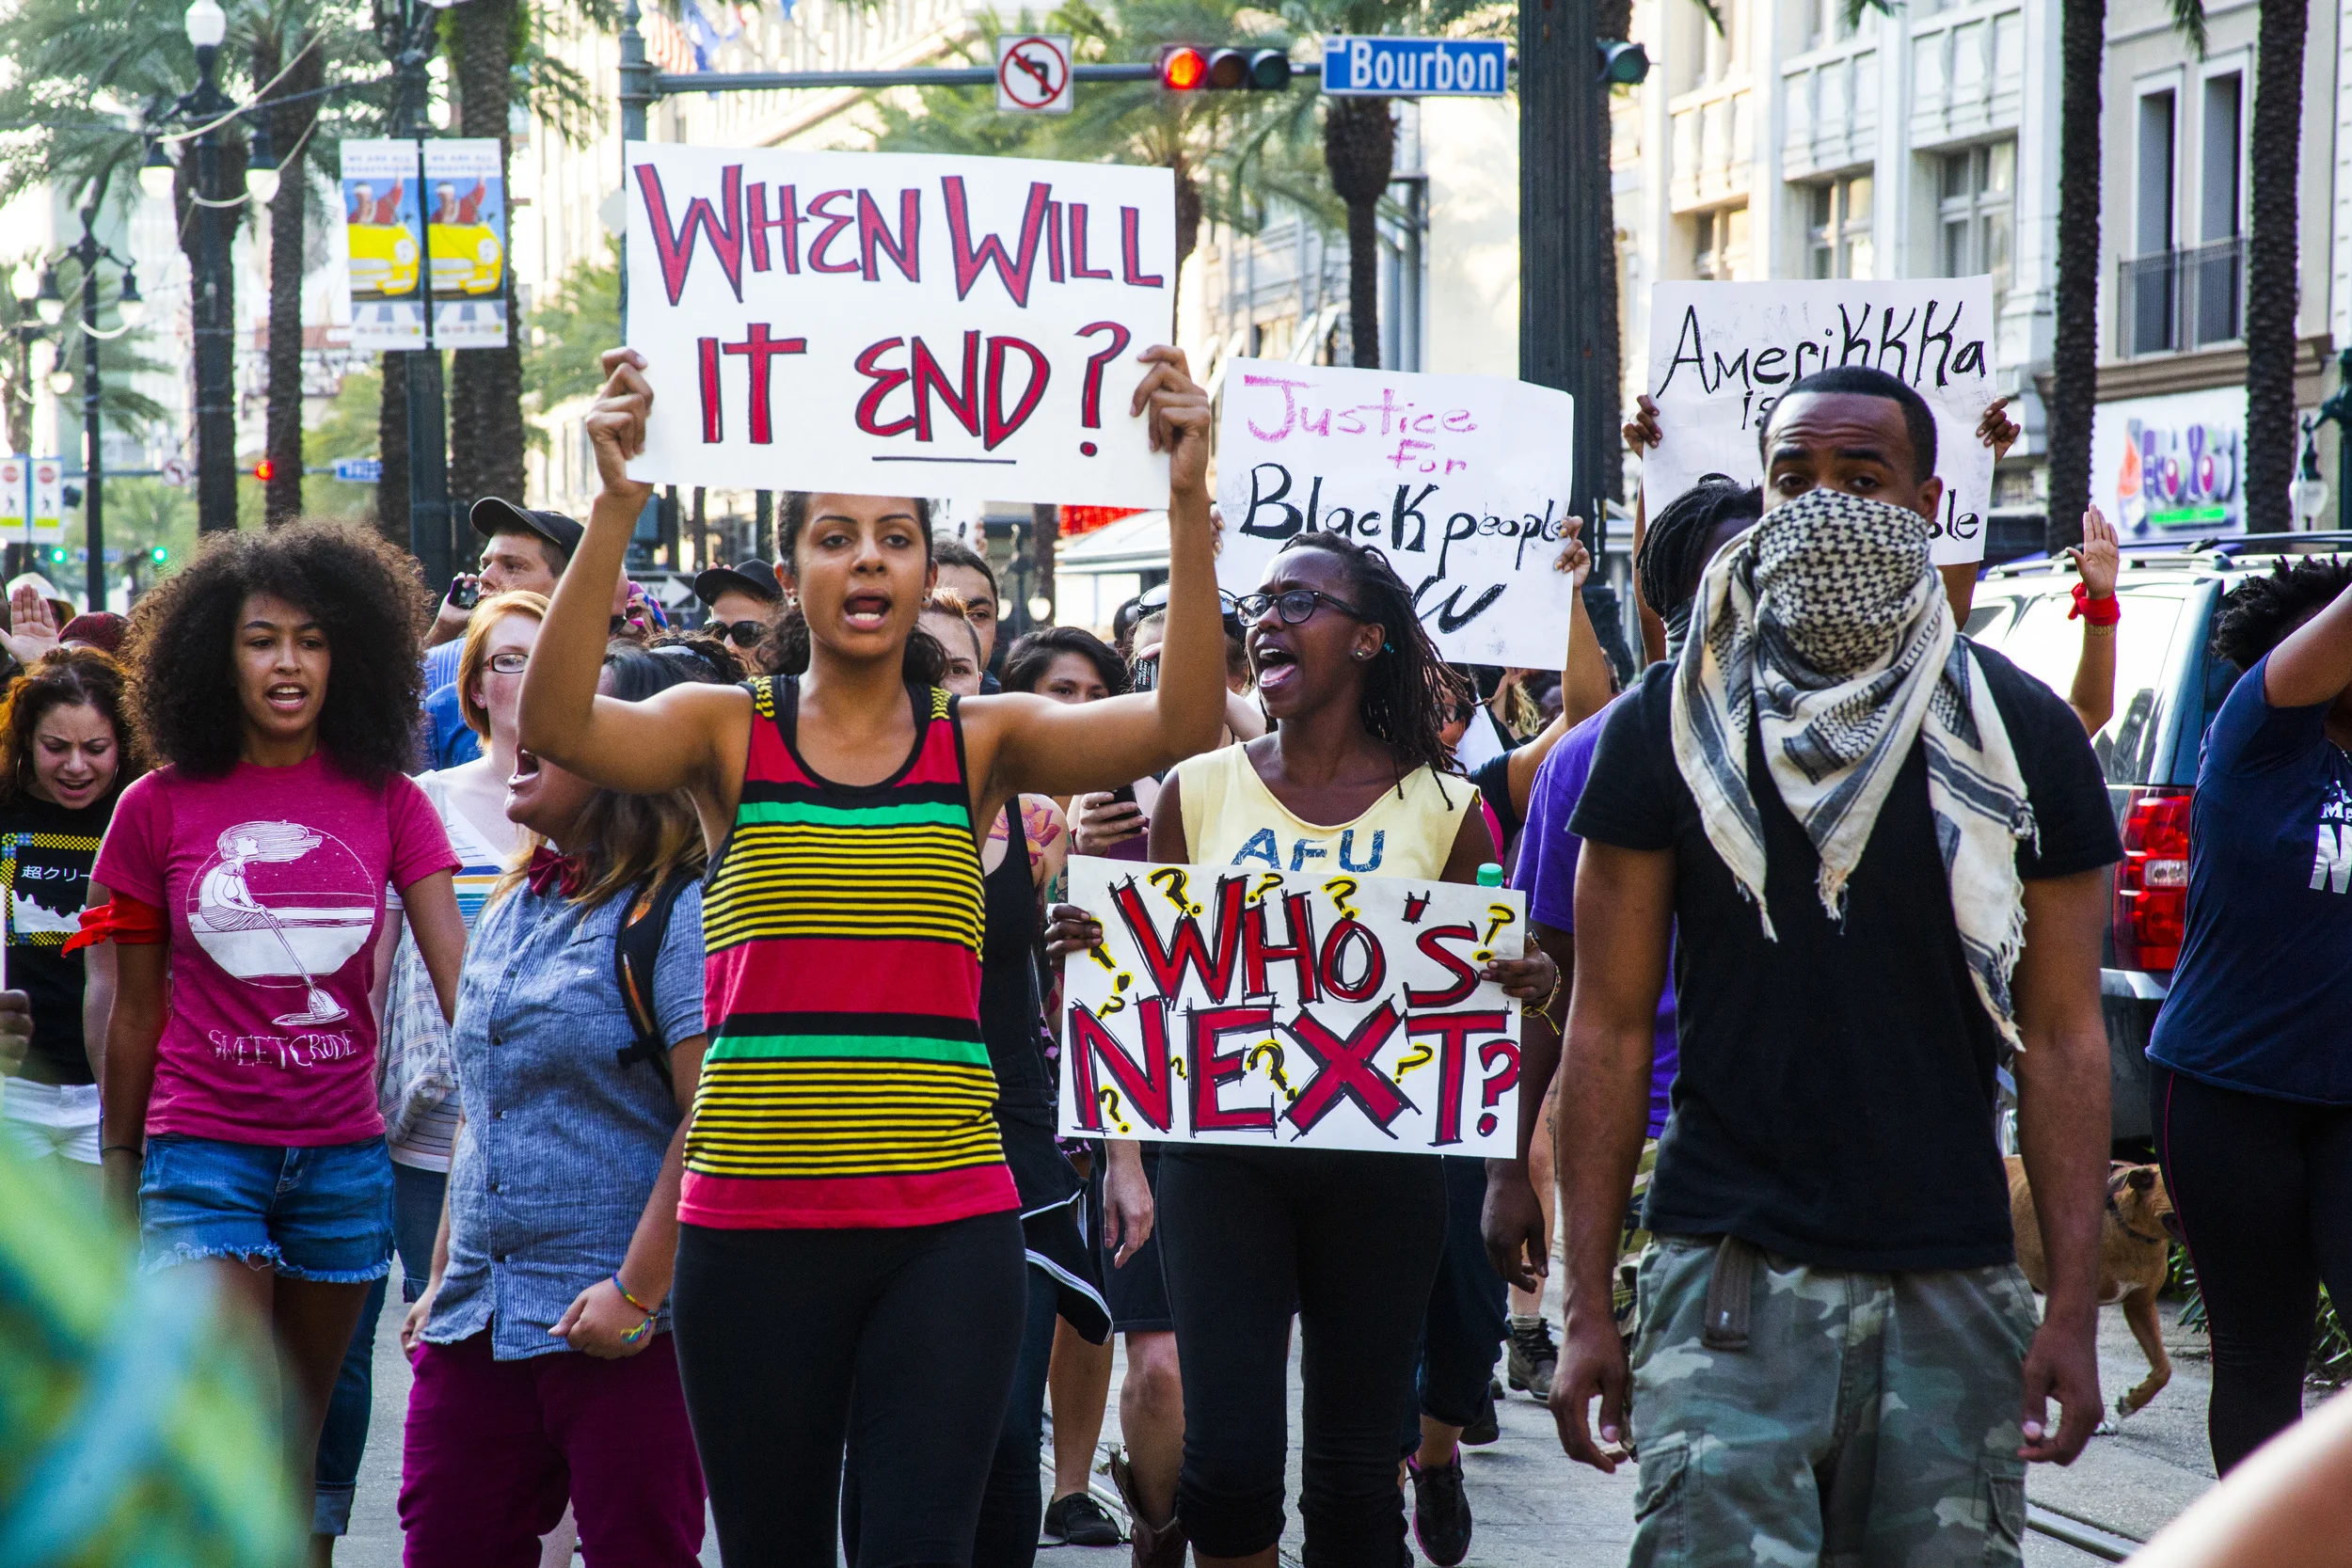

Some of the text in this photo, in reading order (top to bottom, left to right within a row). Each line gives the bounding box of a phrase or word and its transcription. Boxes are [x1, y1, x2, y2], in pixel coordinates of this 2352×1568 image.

[1351, 40, 1498, 90] Bourbon
[633, 164, 1164, 309] WHEN WILL
[697, 323, 807, 445] IT
[1244, 374, 1478, 443] Justice
[1387, 438, 1468, 475] For
[1231, 828, 1386, 873] AFU
[1108, 873, 1481, 1011] WHO'S
